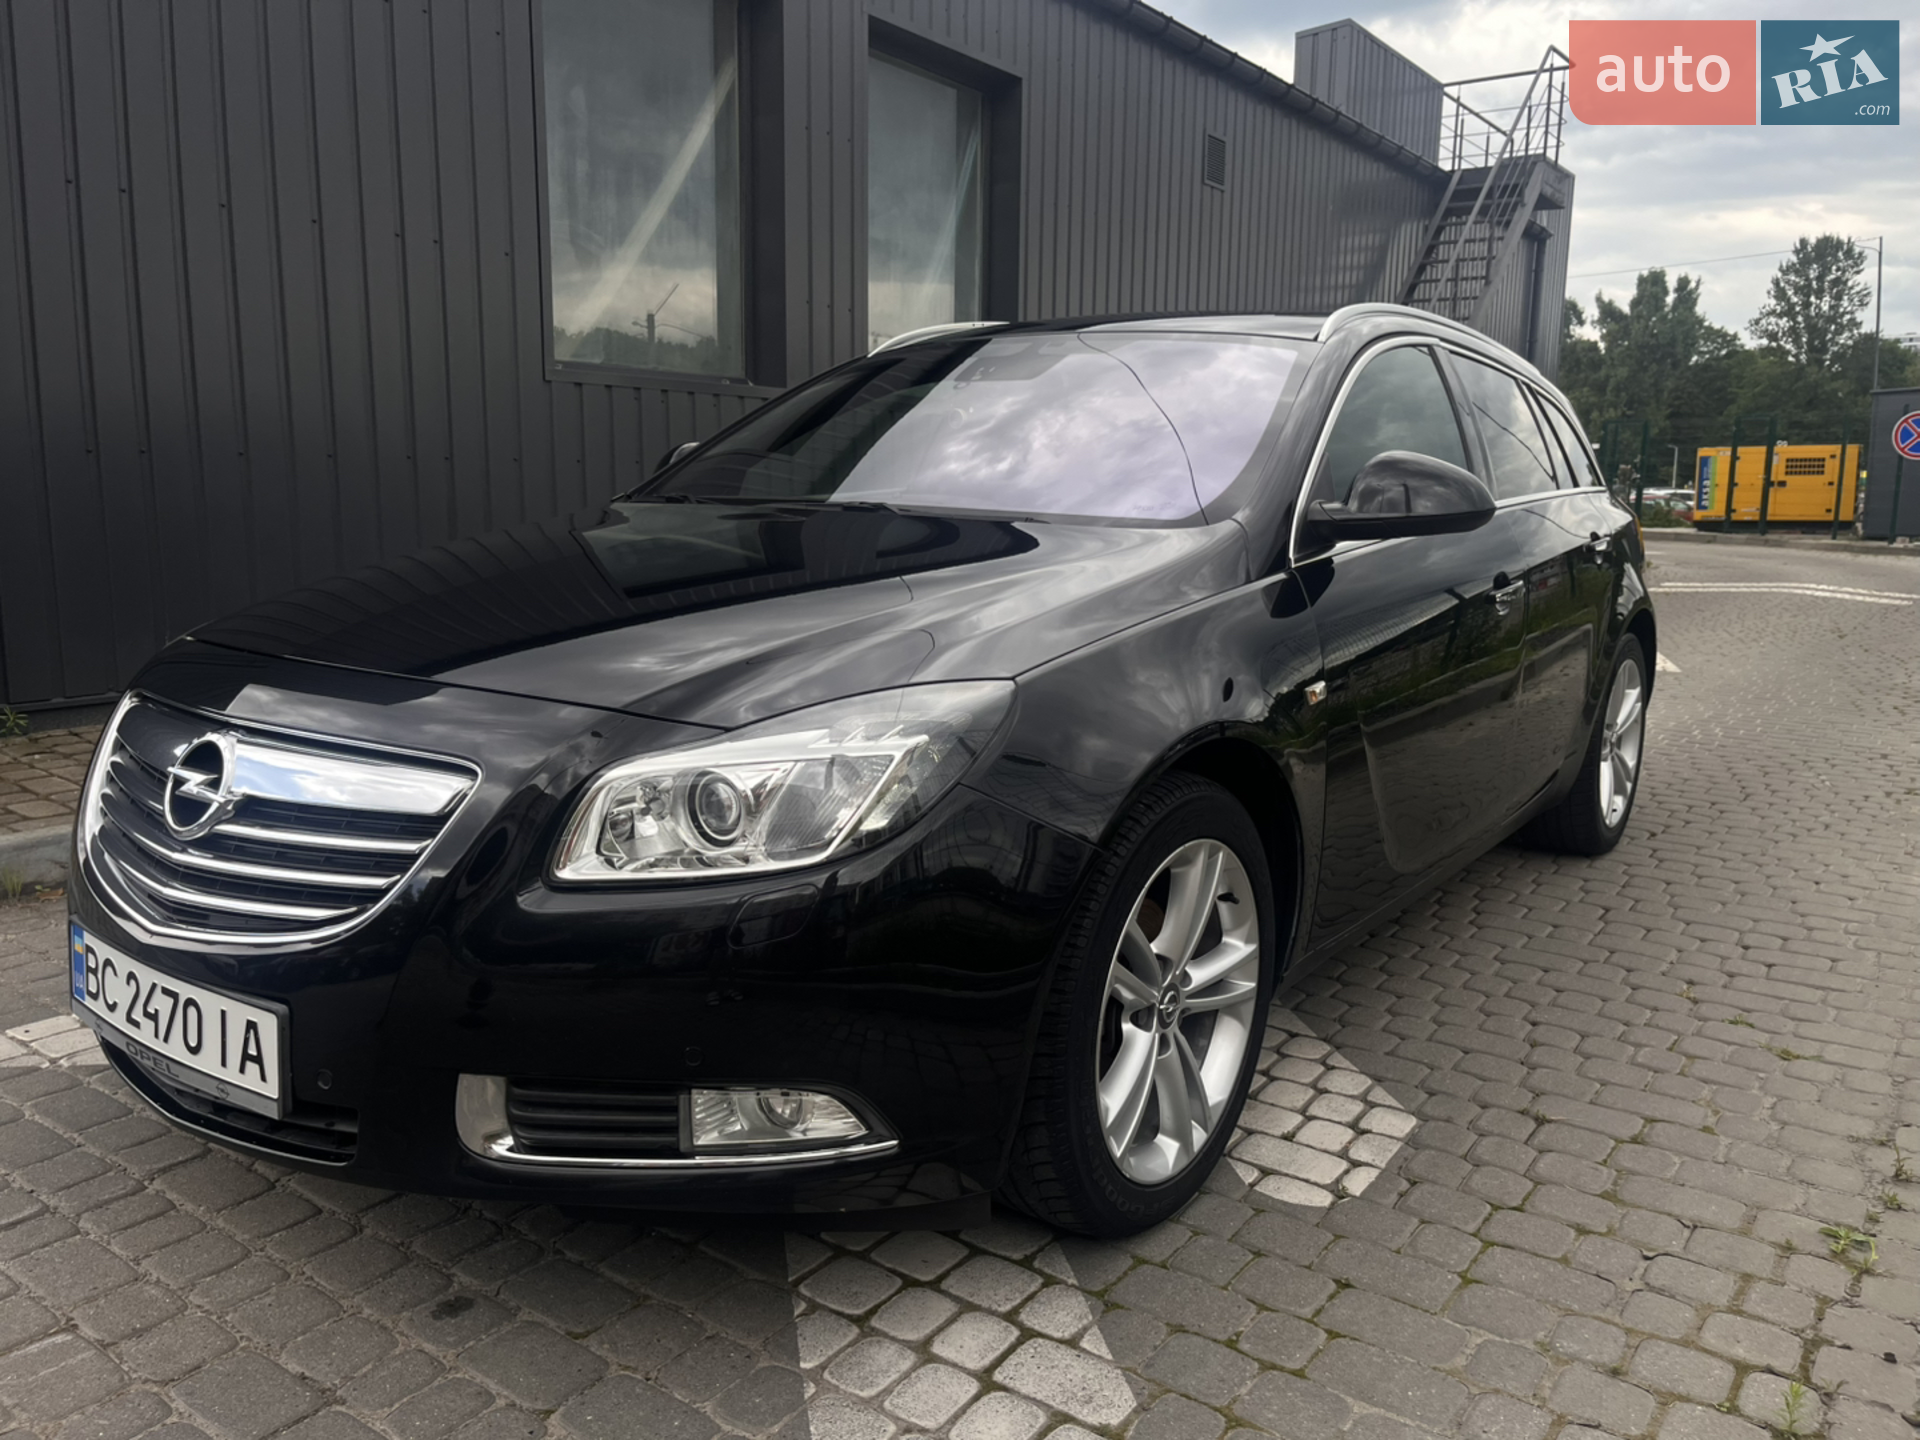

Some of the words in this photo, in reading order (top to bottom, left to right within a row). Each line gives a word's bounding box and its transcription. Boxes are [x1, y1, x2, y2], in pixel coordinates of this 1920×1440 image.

[85, 943, 118, 1013] BC
[125, 970, 203, 1056] 2470
[221, 1007, 268, 1083] IA
[125, 1041, 180, 1079] OPEL
